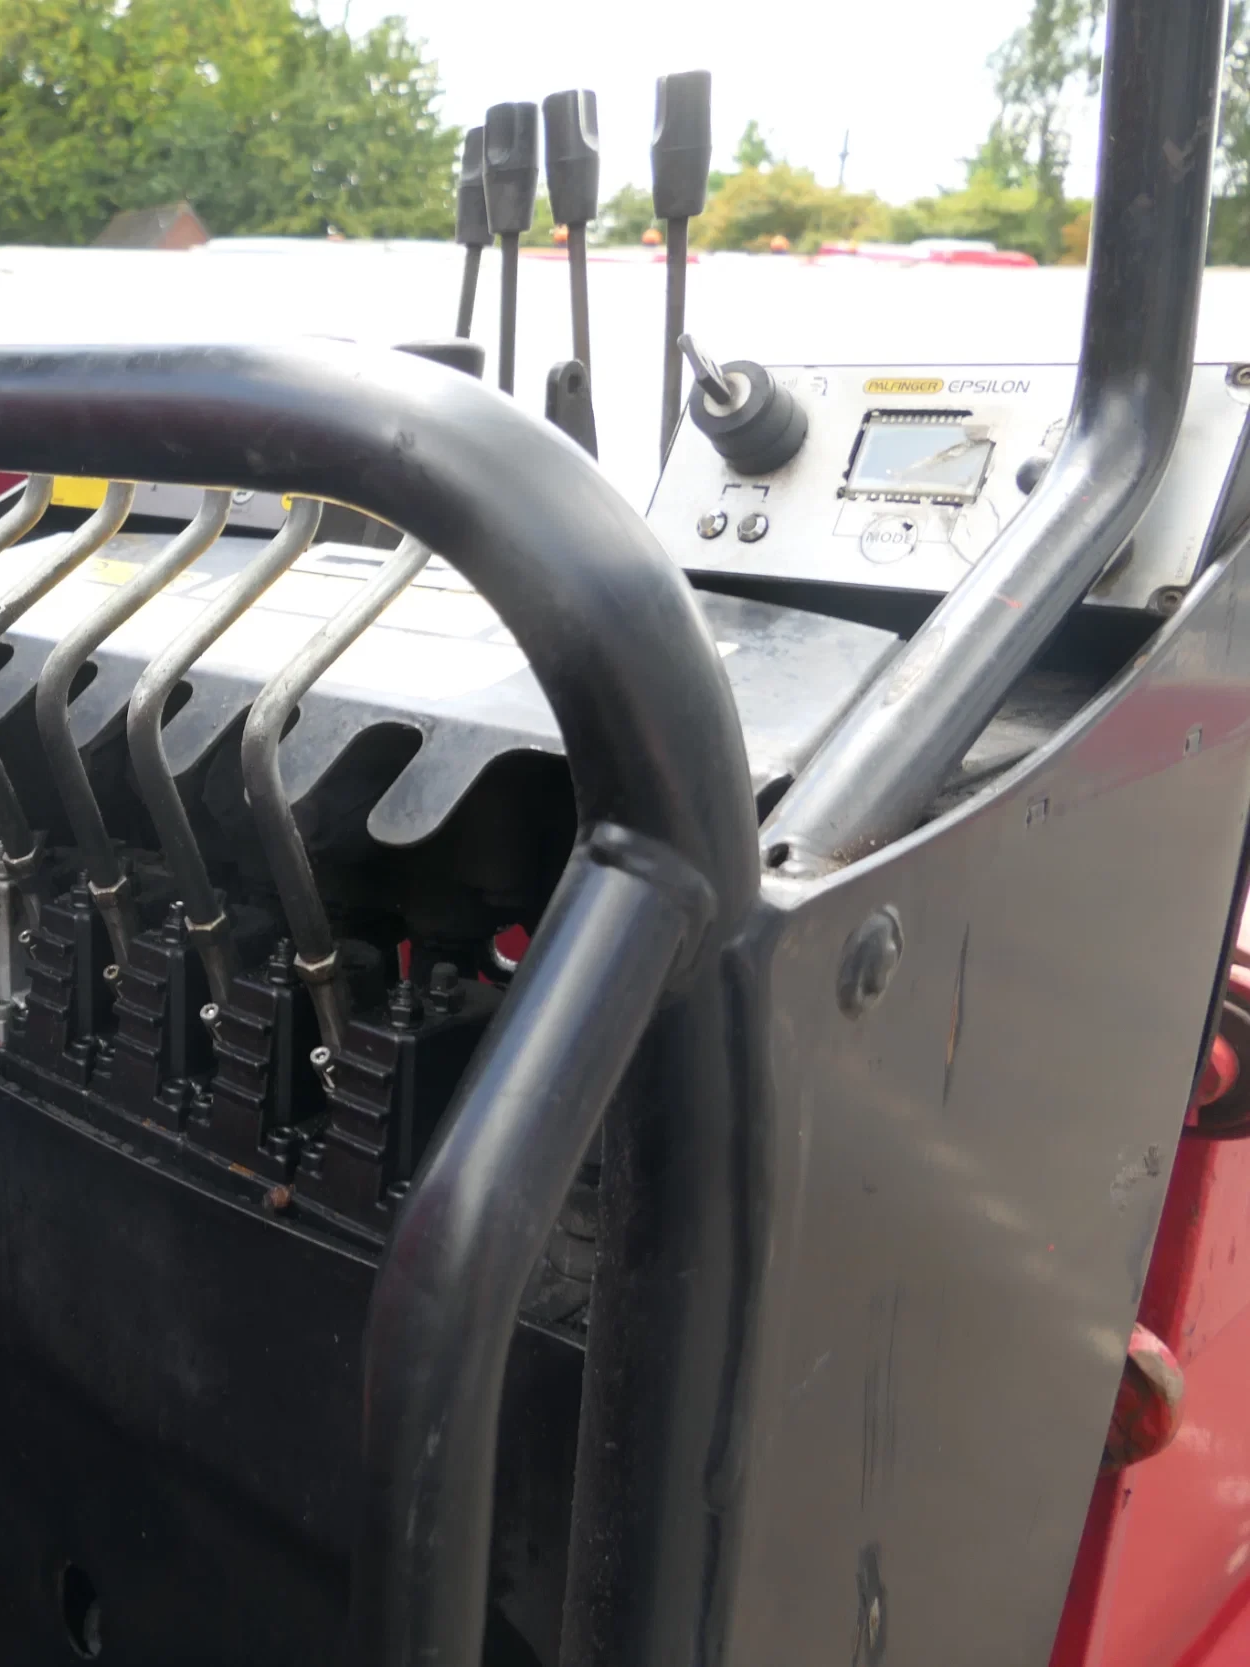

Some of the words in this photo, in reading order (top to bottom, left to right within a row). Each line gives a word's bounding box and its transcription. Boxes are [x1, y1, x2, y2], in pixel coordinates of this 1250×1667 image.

[868, 380, 939, 392] PALFINGER
[948, 380, 1031, 394] EPSILON
[865, 530, 913, 545] MODE
